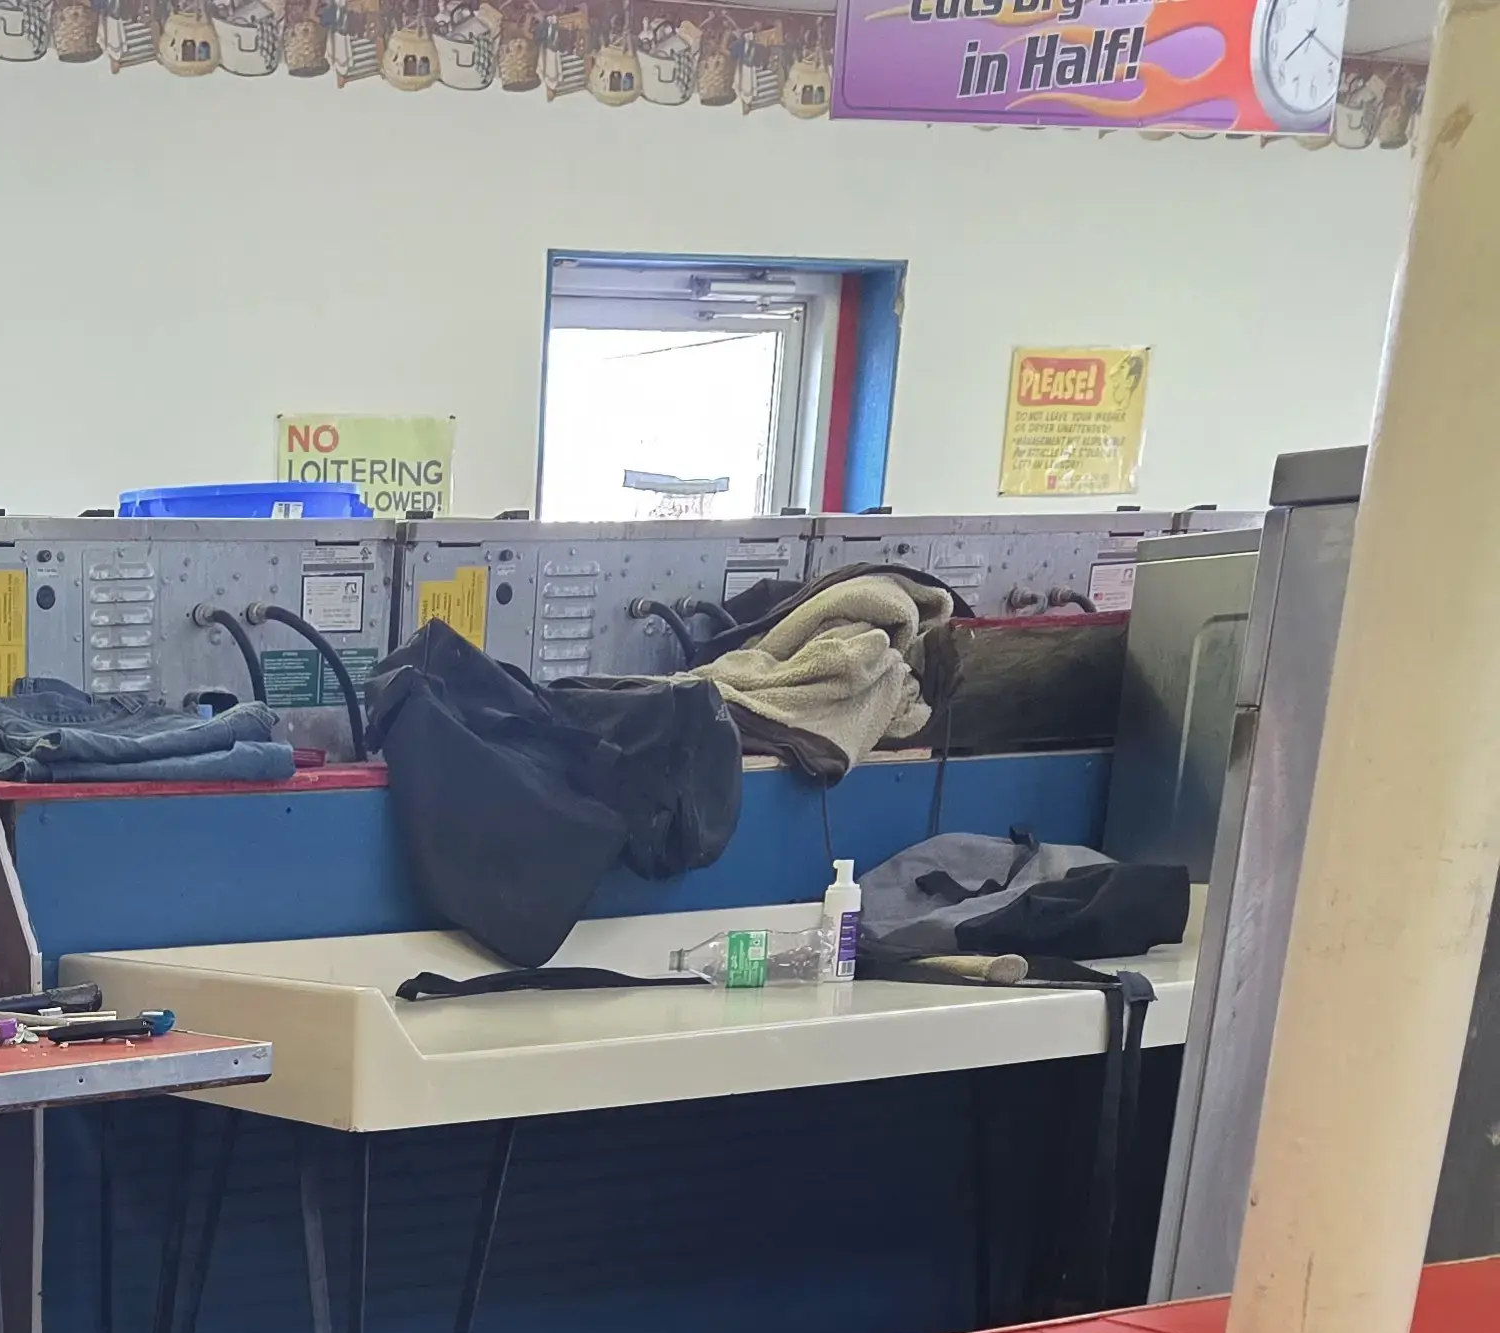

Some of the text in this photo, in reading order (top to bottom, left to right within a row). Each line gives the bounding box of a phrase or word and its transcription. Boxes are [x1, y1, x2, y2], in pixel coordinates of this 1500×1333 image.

[956, 26, 1147, 99] in Half!
[1020, 363, 1098, 401] PLEASE!
[288, 425, 339, 452] NO
[288, 458, 443, 486] LOITERING
[364, 491, 443, 512] LOWED!
